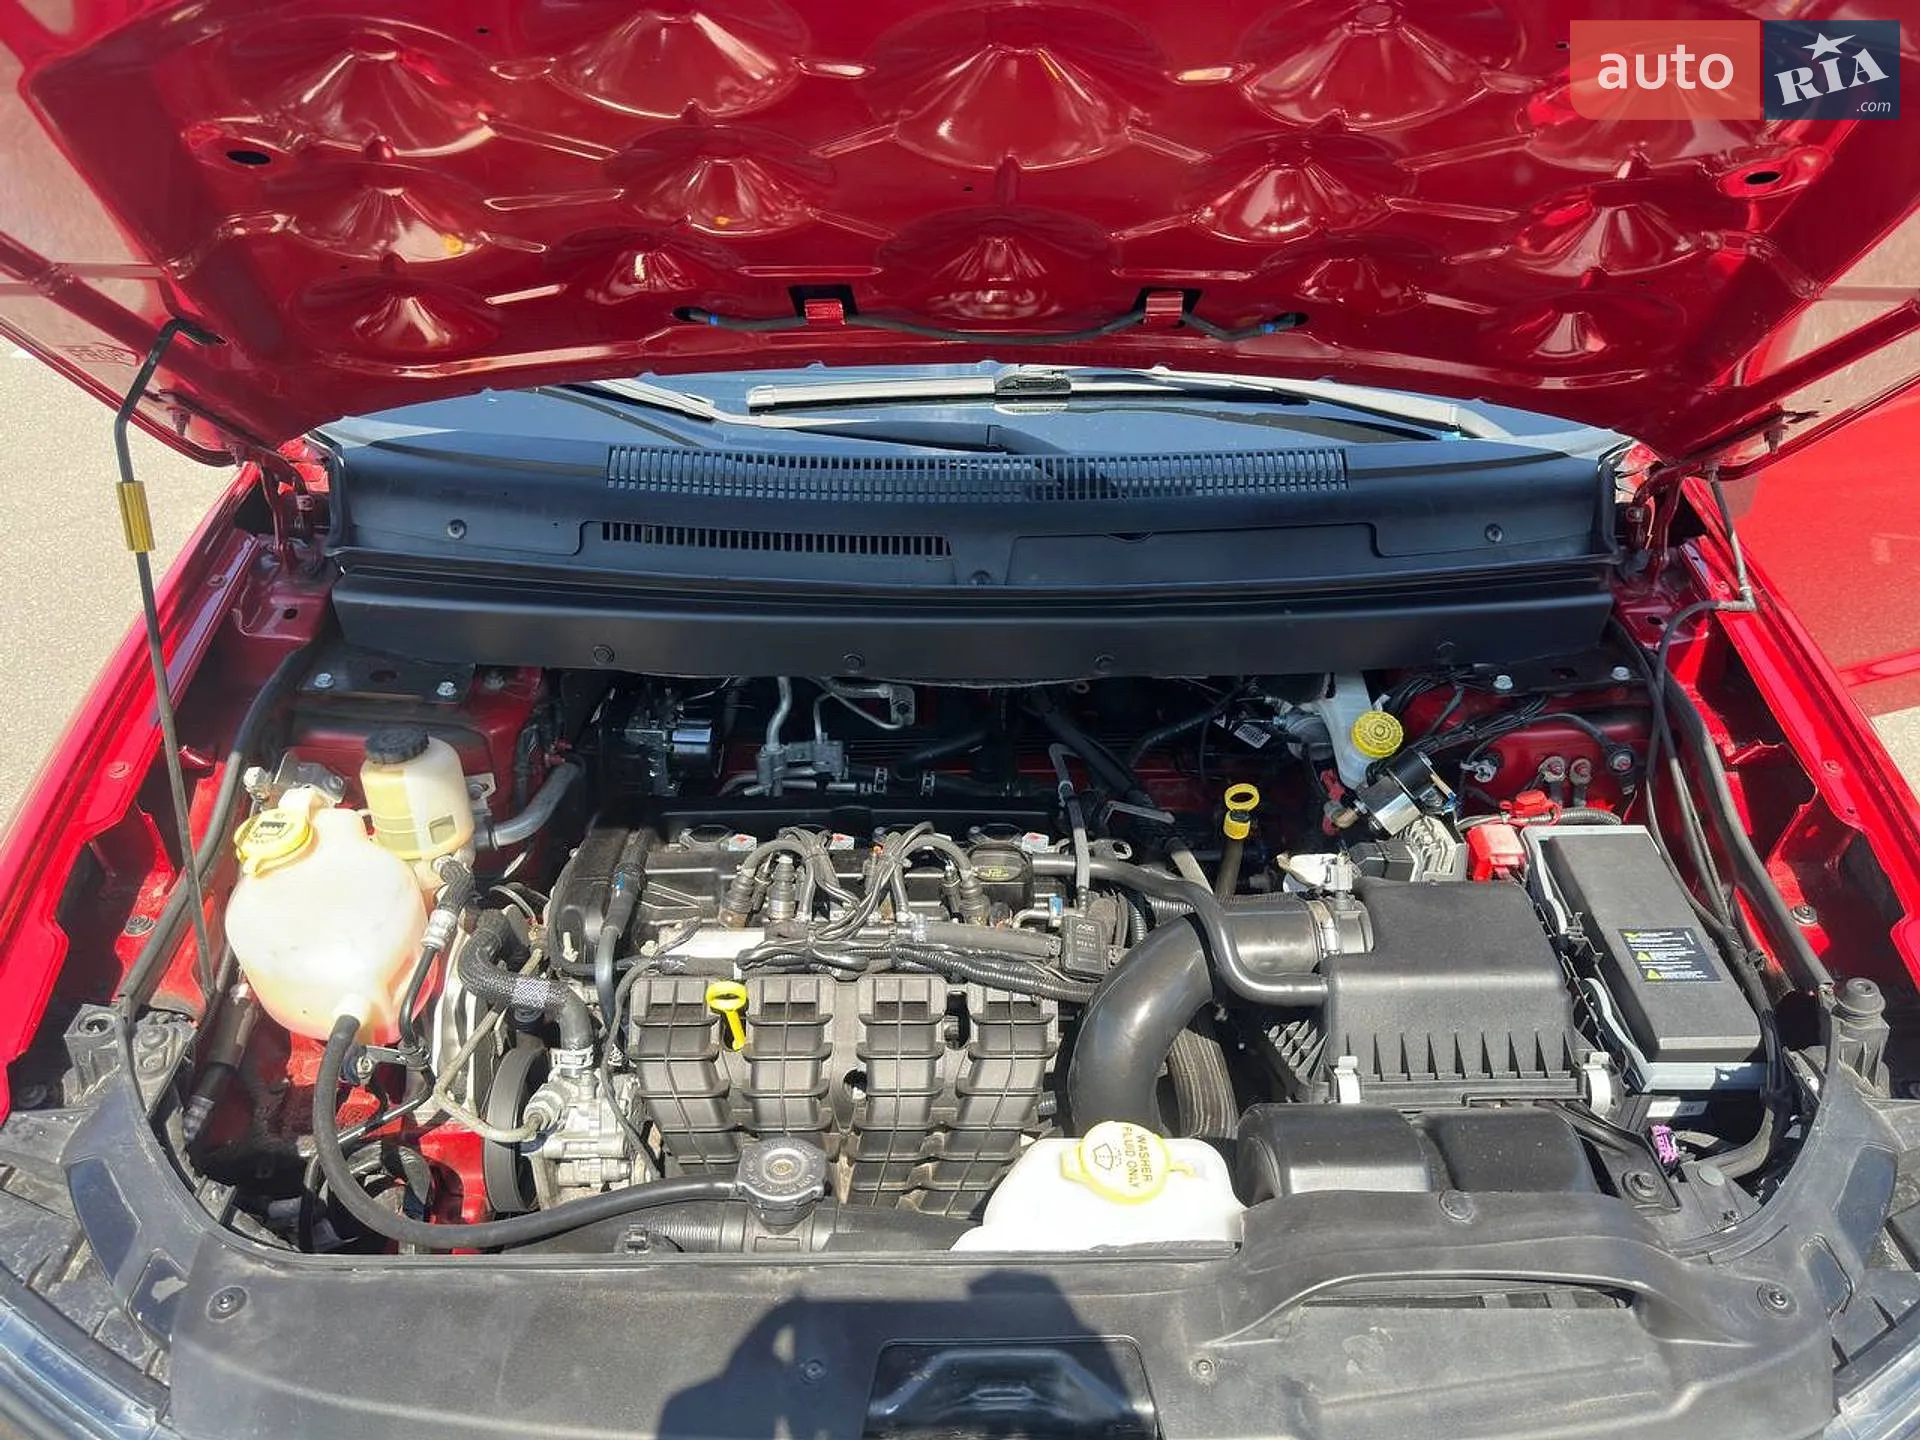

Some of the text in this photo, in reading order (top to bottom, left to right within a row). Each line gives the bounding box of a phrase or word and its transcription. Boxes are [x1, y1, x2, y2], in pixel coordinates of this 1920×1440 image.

[1123, 1127, 1140, 1188] FLUID ONLY
[1137, 1135, 1153, 1182] WASHER
